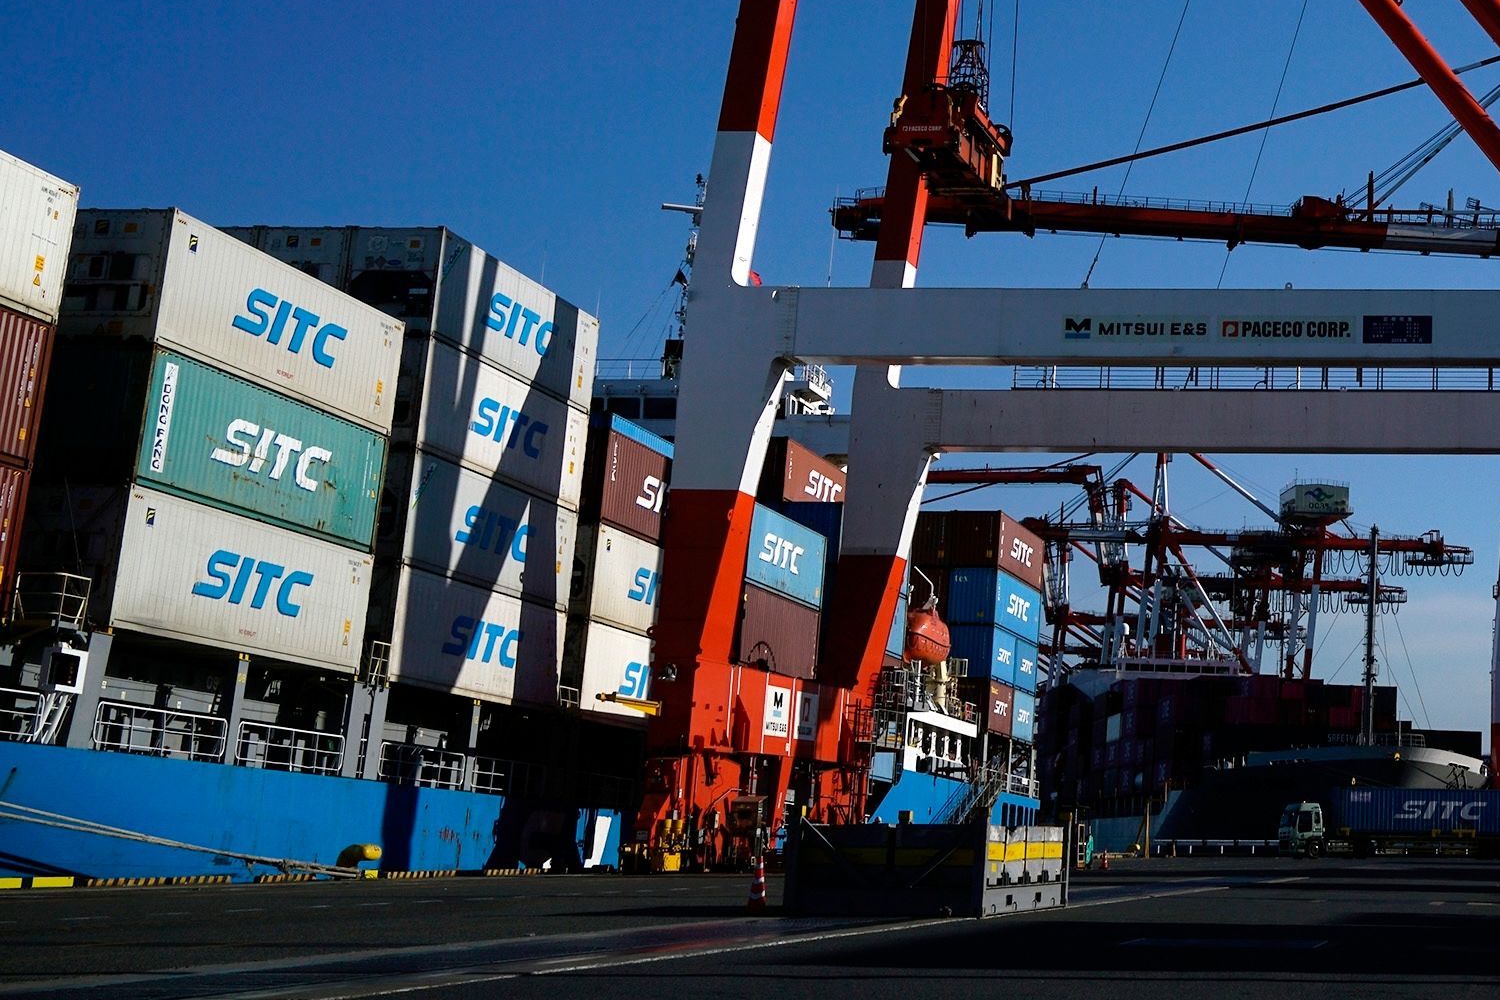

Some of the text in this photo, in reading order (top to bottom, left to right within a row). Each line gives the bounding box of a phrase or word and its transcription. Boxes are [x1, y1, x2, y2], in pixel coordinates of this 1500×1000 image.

[231, 287, 349, 370] SITC
[481, 291, 559, 359] SITC
[1098, 322, 1165, 336] MITSUI
[1170, 322, 1208, 336] E&S
[1241, 319, 1302, 338] PACECO
[1306, 319, 1352, 338] CORP.
[469, 396, 549, 460] SITC
[210, 417, 333, 493] SITC
[635, 474, 667, 513] SI
[804, 468, 843, 503] SITC
[454, 504, 537, 564] SITC
[1010, 537, 1034, 568] SITC
[758, 531, 805, 576] SITC
[191, 549, 315, 618] SITC
[627, 566, 662, 605] SI
[1006, 592, 1031, 623] SITC
[441, 615, 525, 669] SITC
[996, 647, 1012, 665] SITC
[618, 661, 653, 699] SI
[1020, 658, 1034, 675] SITC
[993, 699, 1009, 717] SITC
[1393, 799, 1489, 821] SITC
